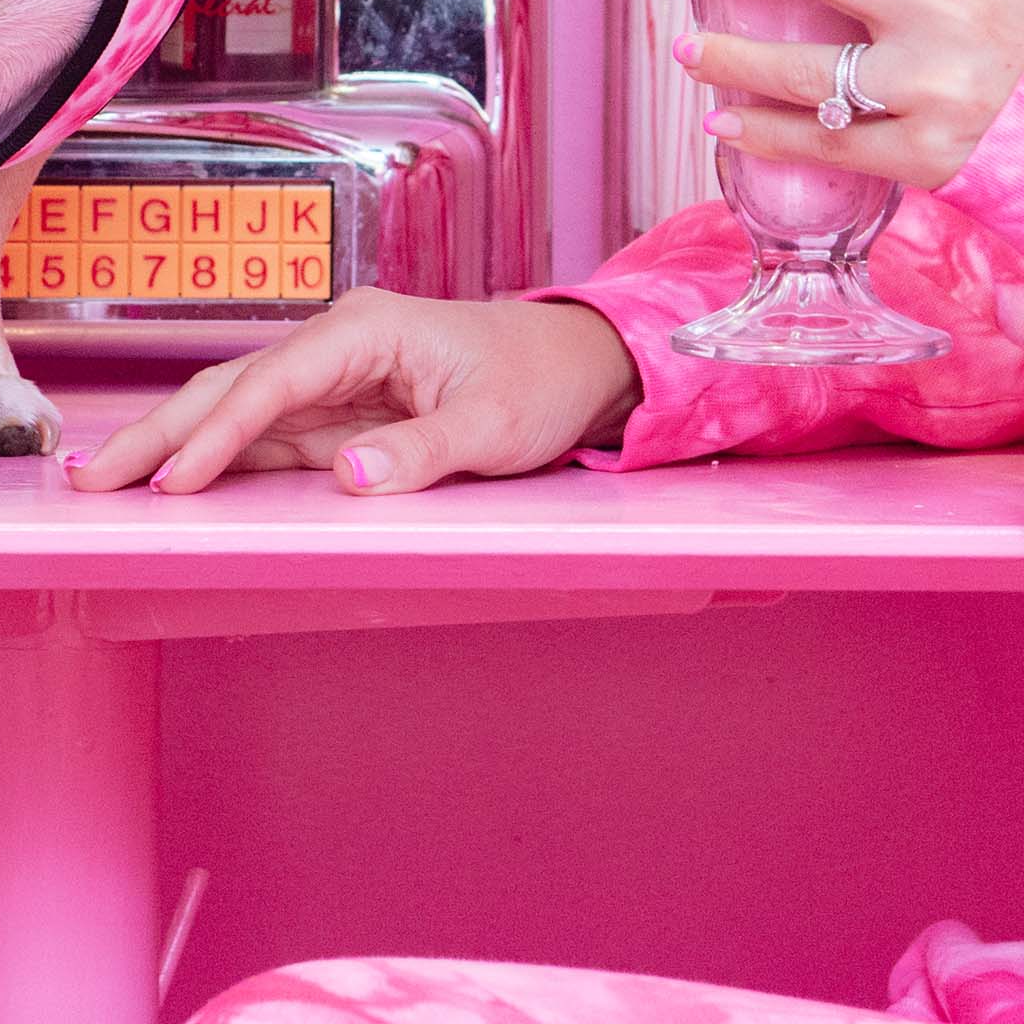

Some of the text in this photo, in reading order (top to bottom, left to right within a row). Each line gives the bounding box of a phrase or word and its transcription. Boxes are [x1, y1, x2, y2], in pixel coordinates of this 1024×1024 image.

[40, 197, 67, 233] E
[92, 198, 117, 233] F
[140, 198, 171, 233] G
[191, 199, 219, 233] H
[246, 200, 267, 235] J
[292, 200, 319, 235] K
[41, 255, 66, 289] 5
[91, 255, 115, 289] 6
[143, 255, 167, 289] 7
[191, 255, 217, 289] 8
[243, 256, 268, 290] 9
[287, 255, 323, 289] 10
